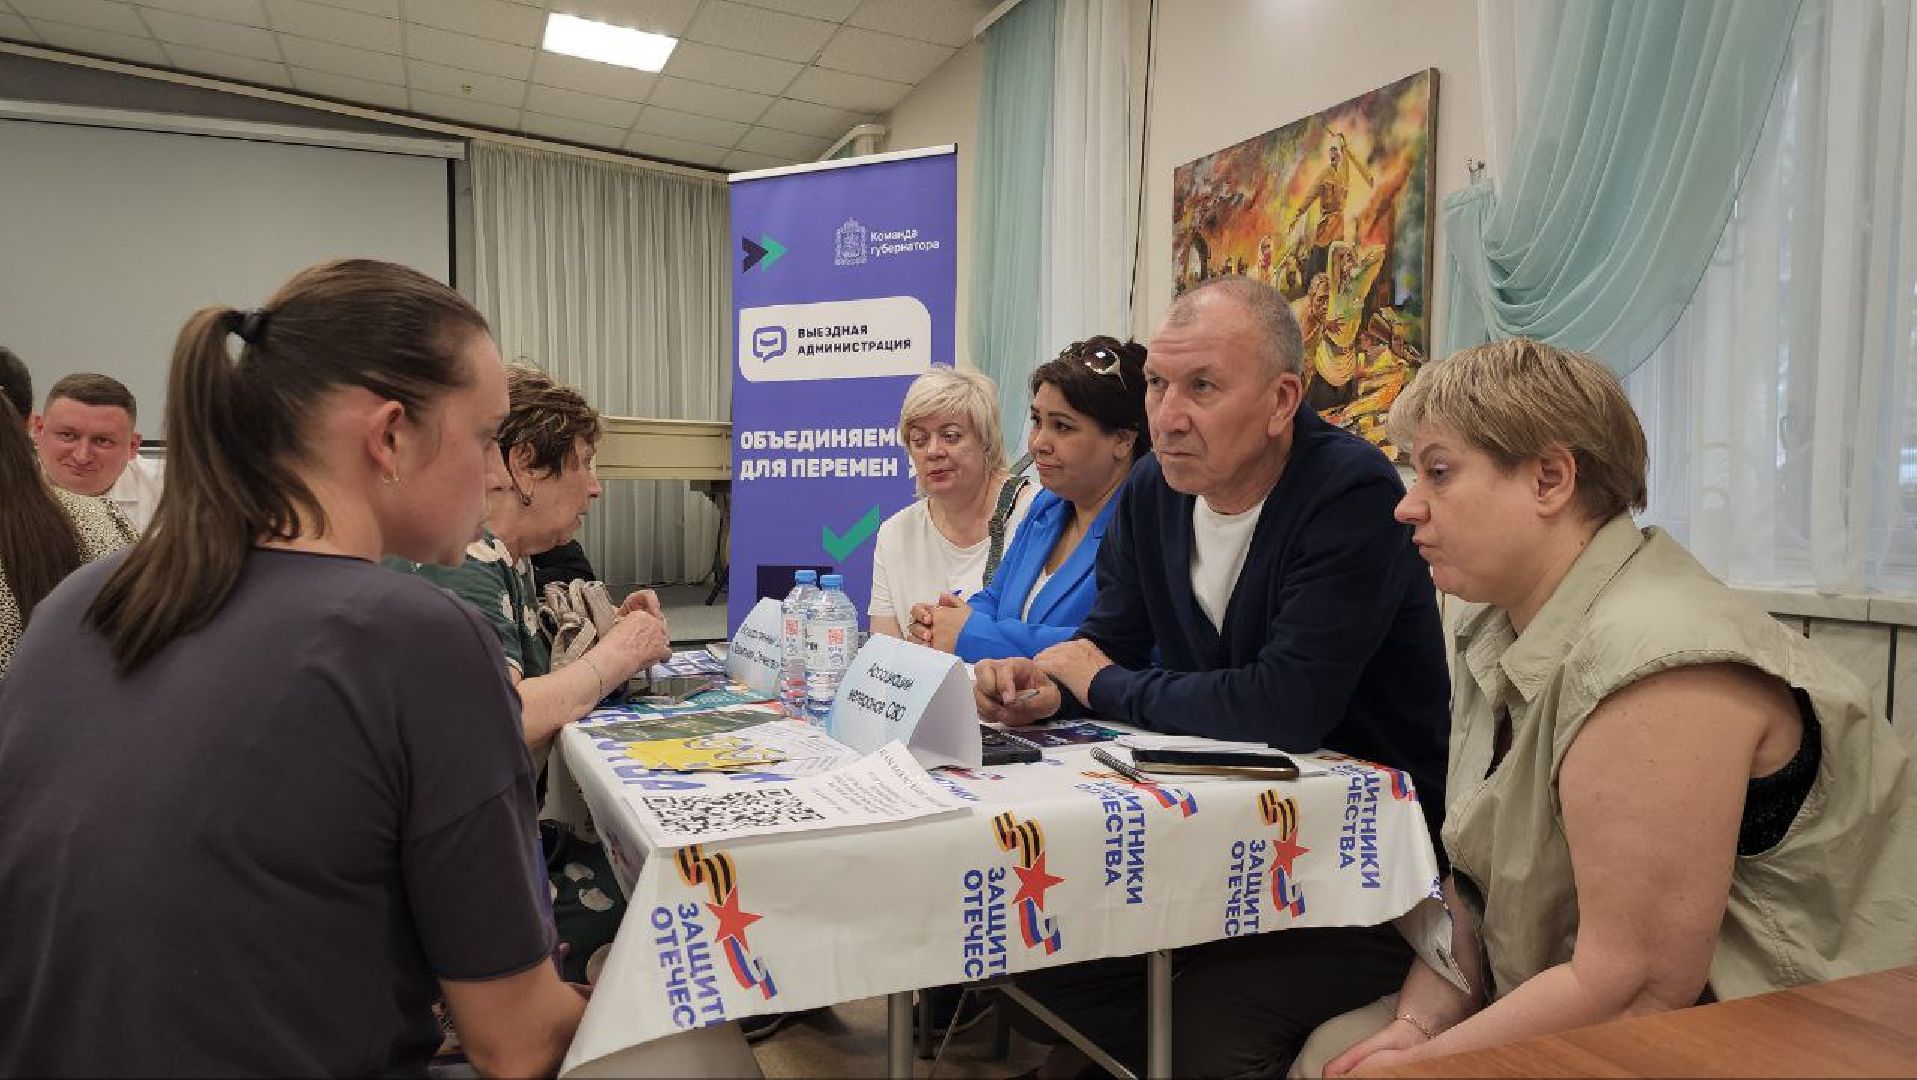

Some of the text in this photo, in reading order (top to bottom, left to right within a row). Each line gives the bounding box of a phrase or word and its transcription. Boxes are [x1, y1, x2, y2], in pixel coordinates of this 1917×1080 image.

[870, 229, 919, 242] Команда
[870, 241, 940, 257] губернатора
[797, 325, 868, 339] ВЫЕЗДНАЯ
[797, 339, 911, 356] АДМИНИСТРАЦИЯ
[740, 458, 898, 481] ДЛЯ ПЕРЕМЕН
[1243, 839, 1266, 935] ЗАЩИТ
[963, 869, 983, 978] ОТЕЧЕС
[650, 906, 696, 1028] ОТЕЧЕС
